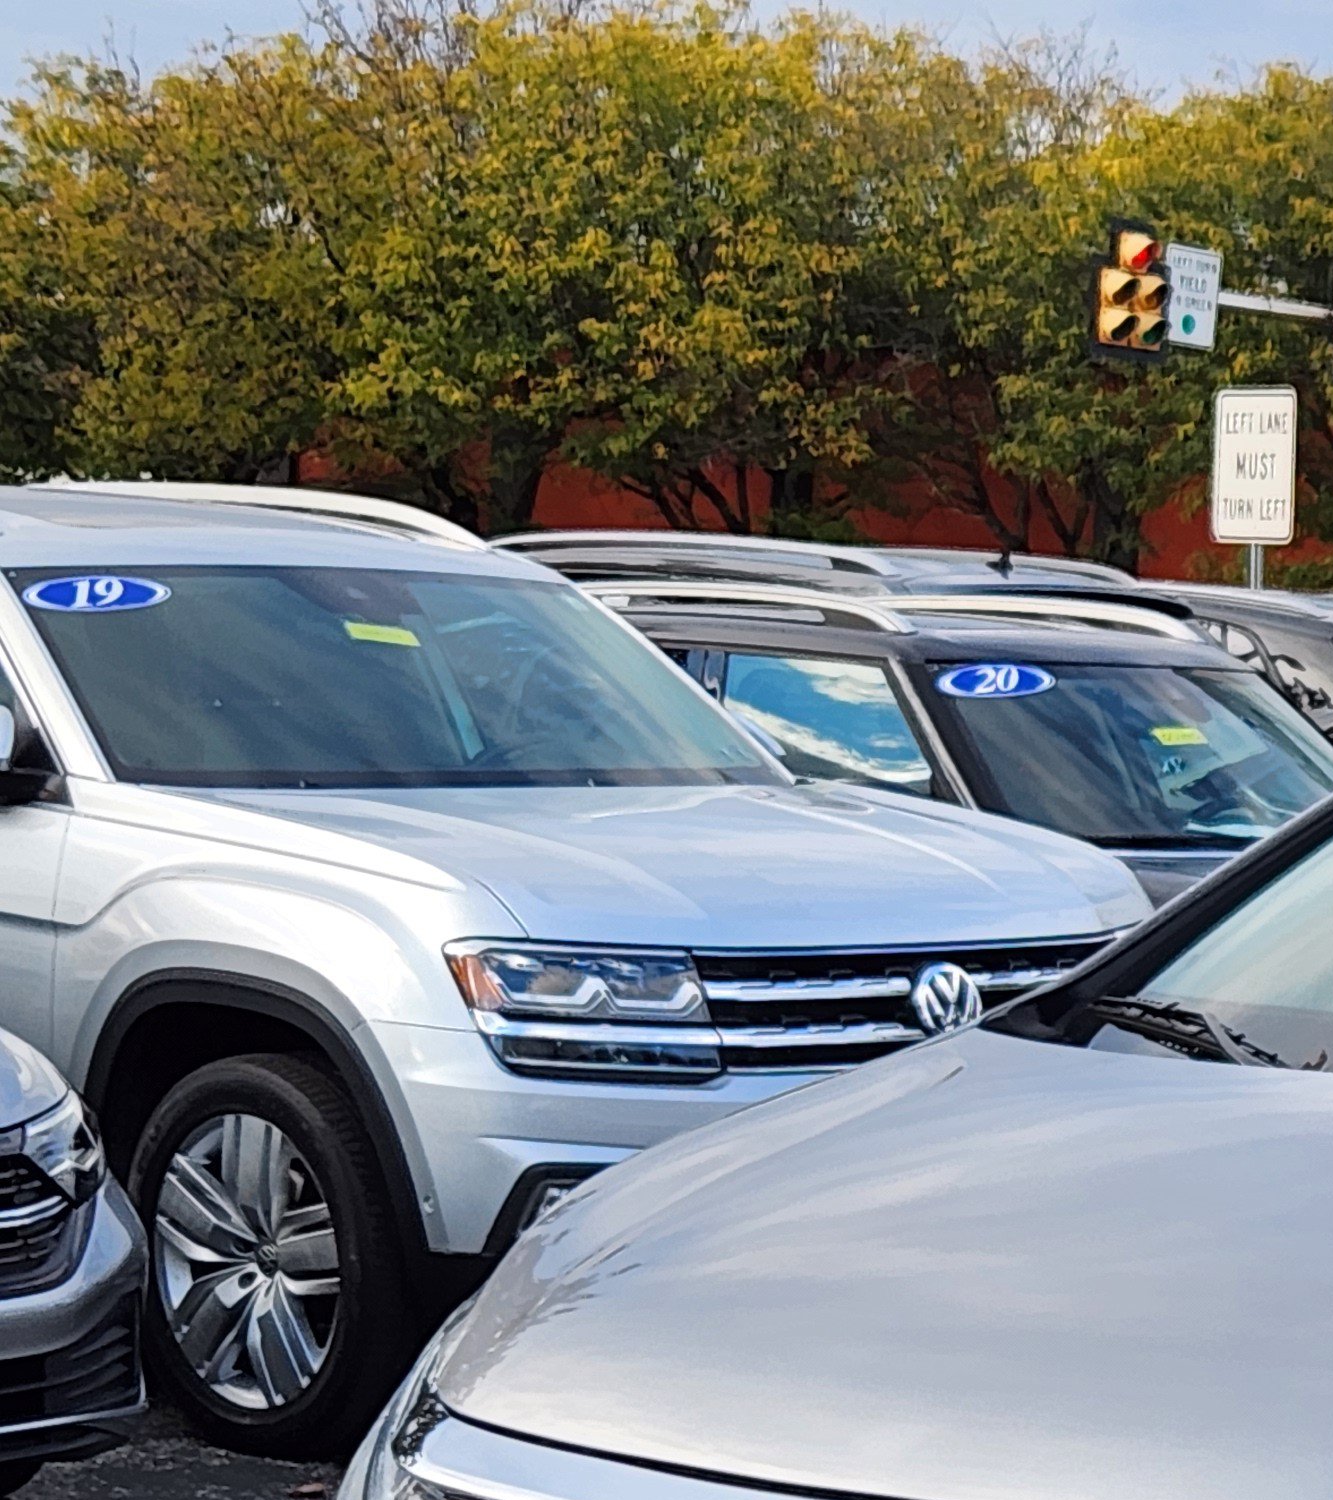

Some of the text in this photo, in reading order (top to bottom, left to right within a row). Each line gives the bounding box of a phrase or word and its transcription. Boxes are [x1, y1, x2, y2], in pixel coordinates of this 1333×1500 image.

[1225, 412, 1289, 435] LEFT LANE
[1235, 452, 1277, 480] MUST
[1223, 497, 1287, 521] TURN LEFT
[72, 577, 125, 609] 19
[973, 666, 1020, 695] 20
